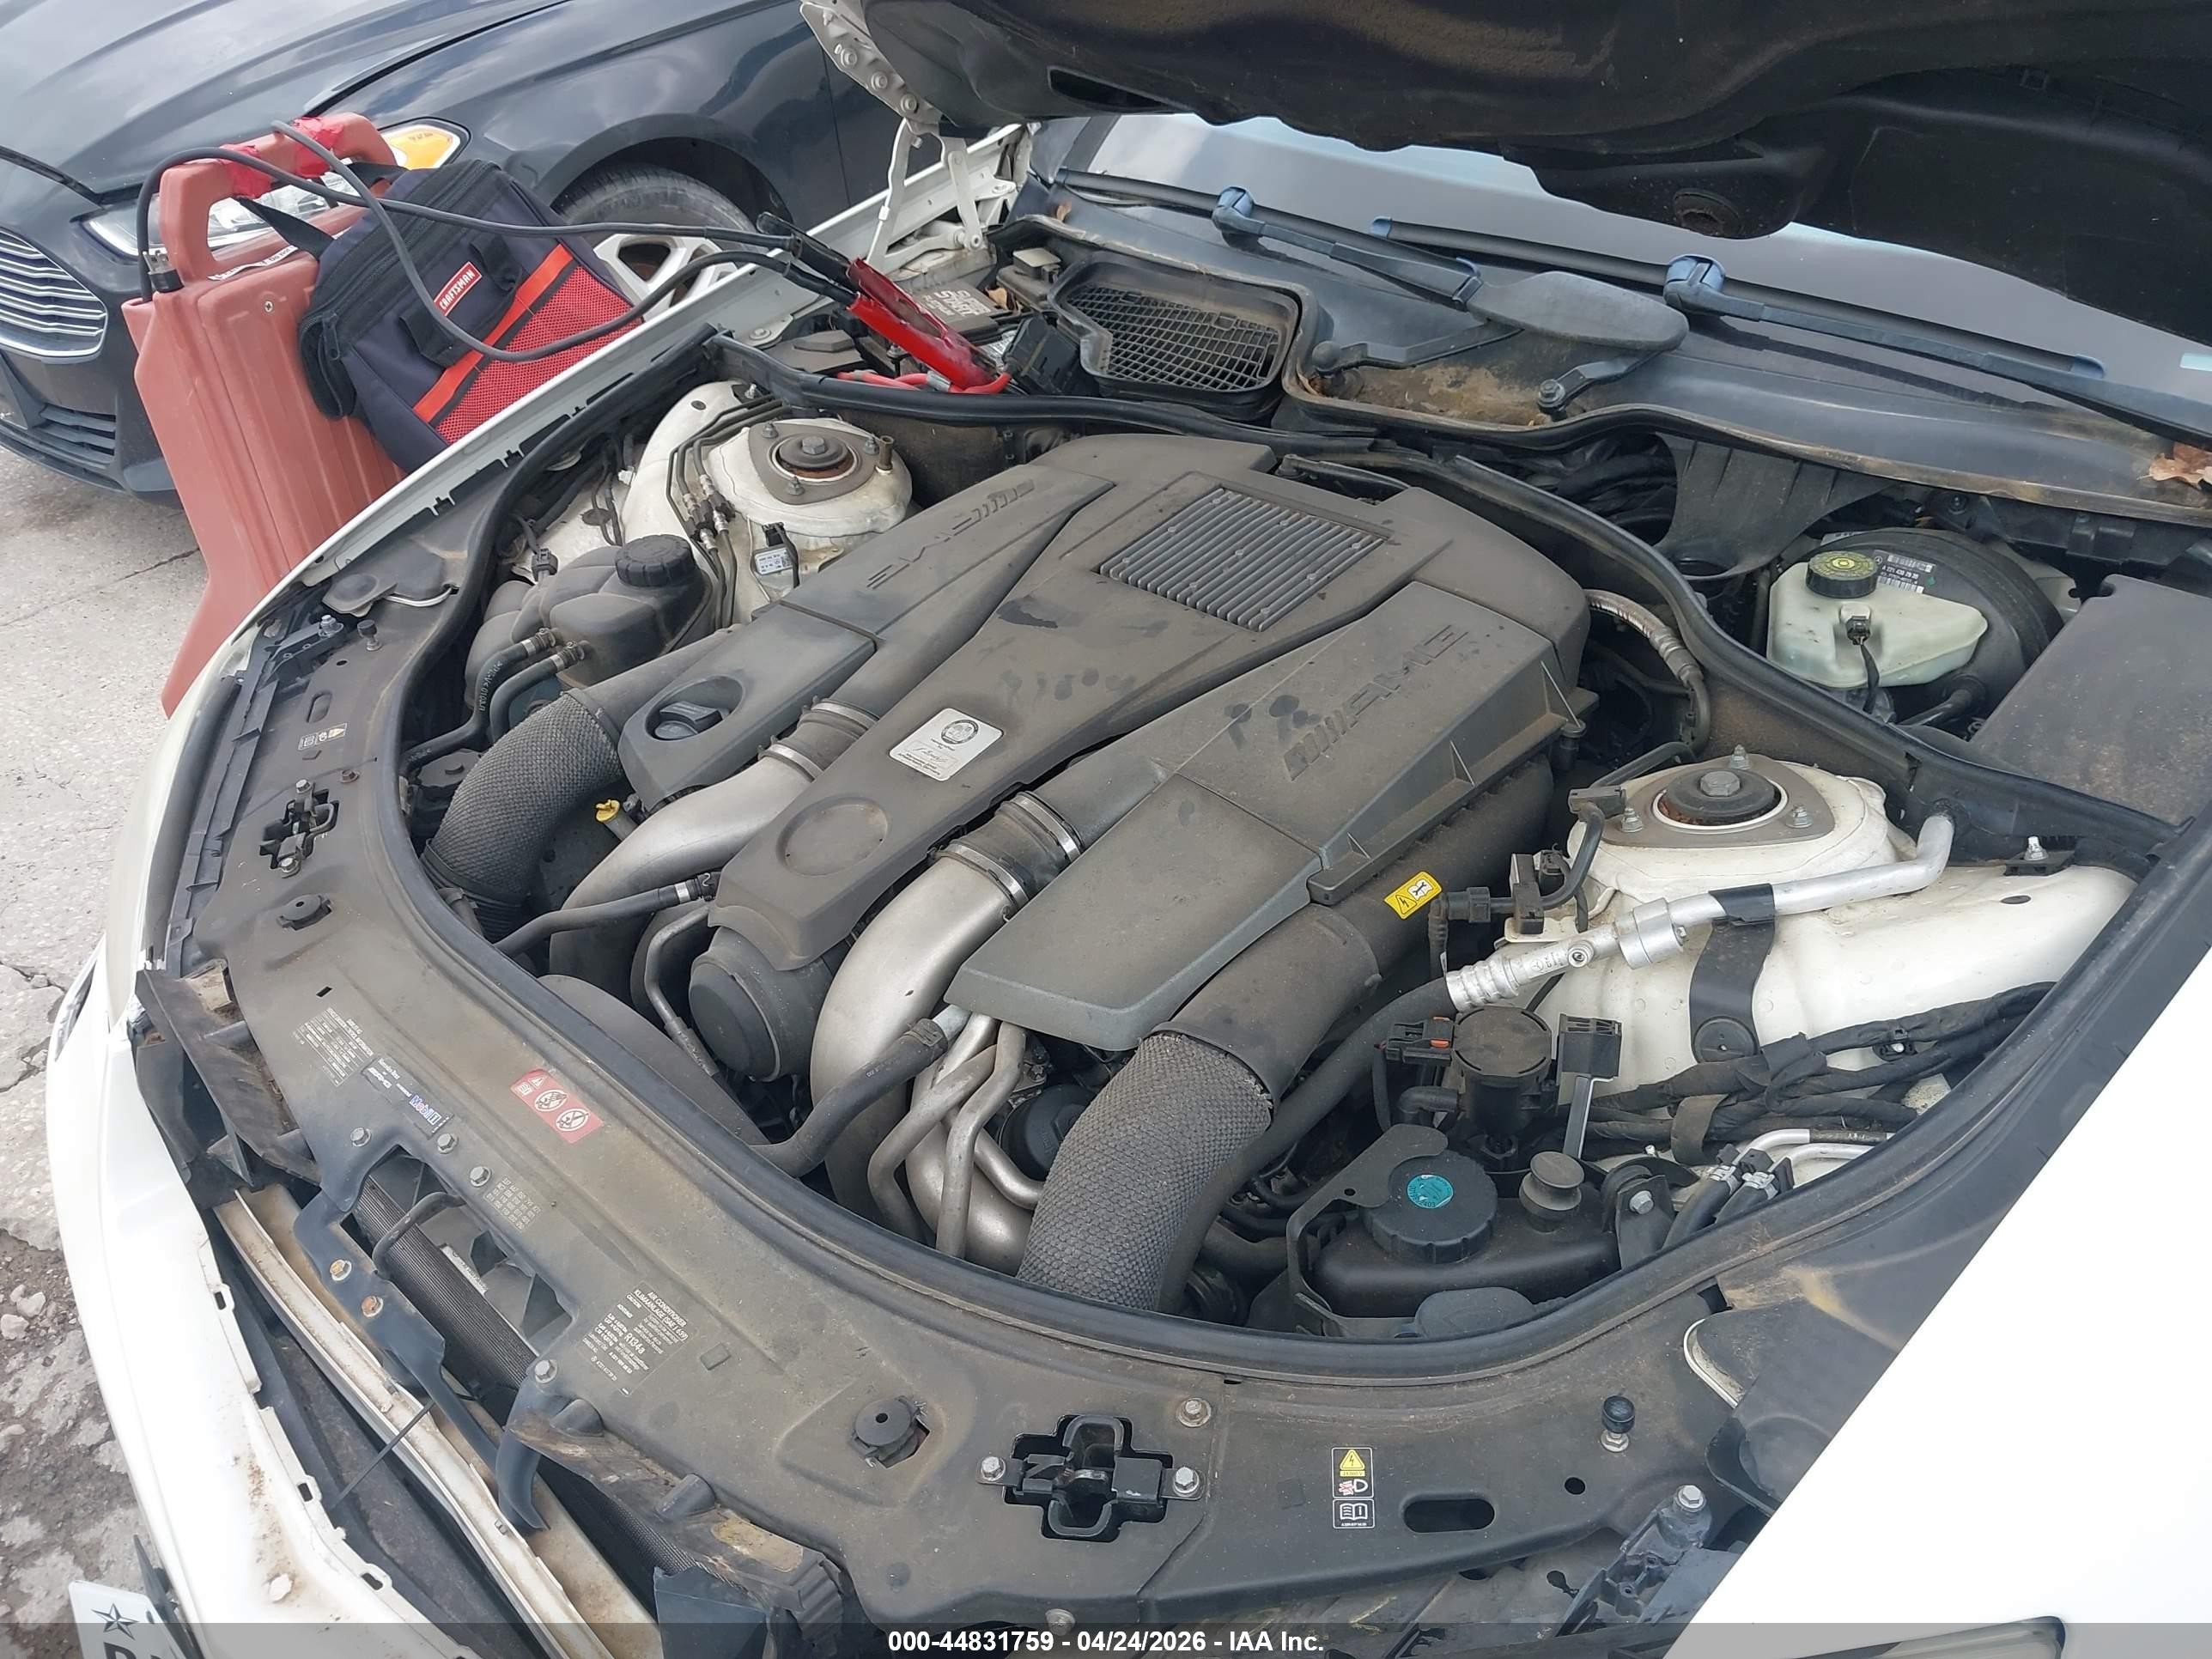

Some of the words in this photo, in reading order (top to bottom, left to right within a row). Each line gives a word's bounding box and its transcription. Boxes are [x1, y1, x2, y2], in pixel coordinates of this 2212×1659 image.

[439, 269, 476, 310] CRAFTSMAN
[409, 1095, 434, 1118] Mobil
[634, 1289, 665, 1319] KLIMAANLAGE
[647, 1291, 658, 1301] AIR
[655, 1298, 686, 1328] CONDITIONER
[623, 1332, 646, 1353] R134a
